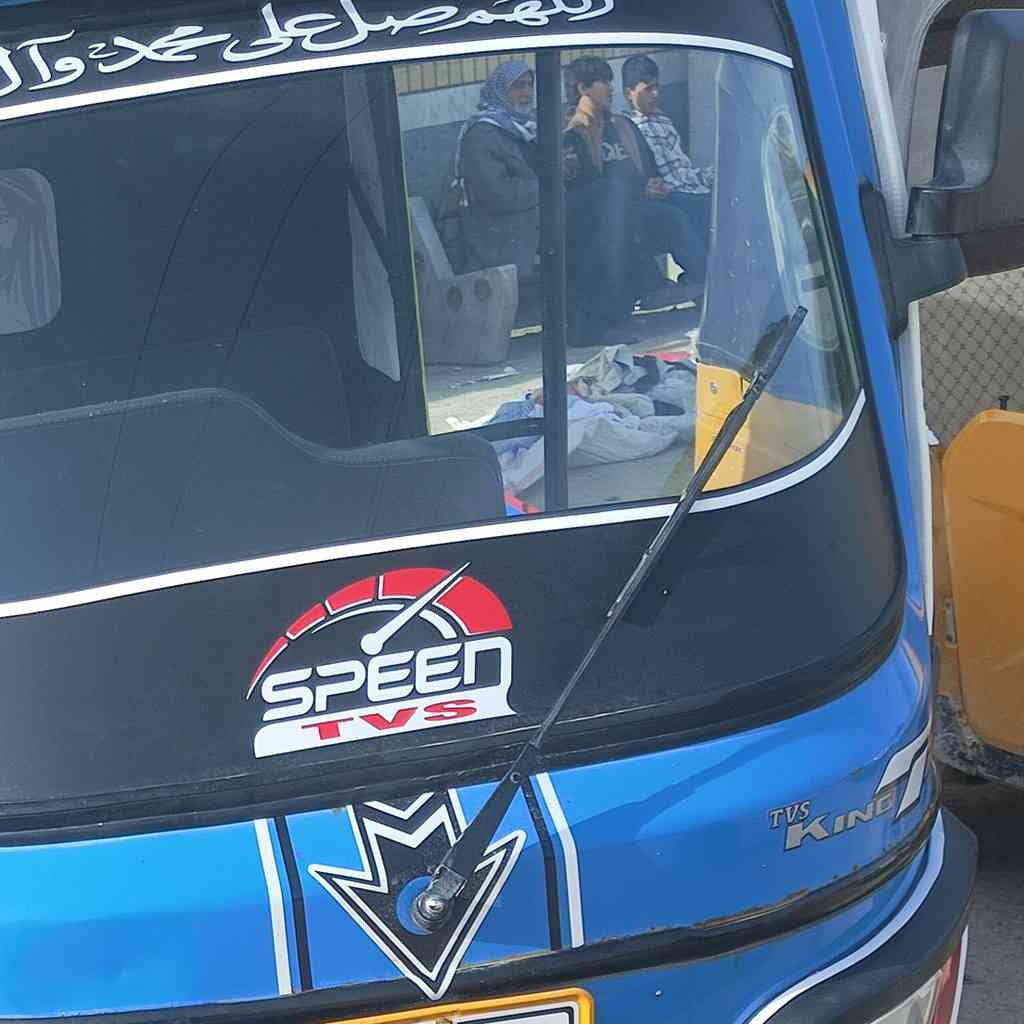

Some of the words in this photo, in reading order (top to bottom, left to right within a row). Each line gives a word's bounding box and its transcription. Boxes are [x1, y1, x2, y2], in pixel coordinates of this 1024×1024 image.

[261, 636, 513, 722] SPEED
[300, 699, 478, 741] TVS
[768, 800, 812, 829] TVS
